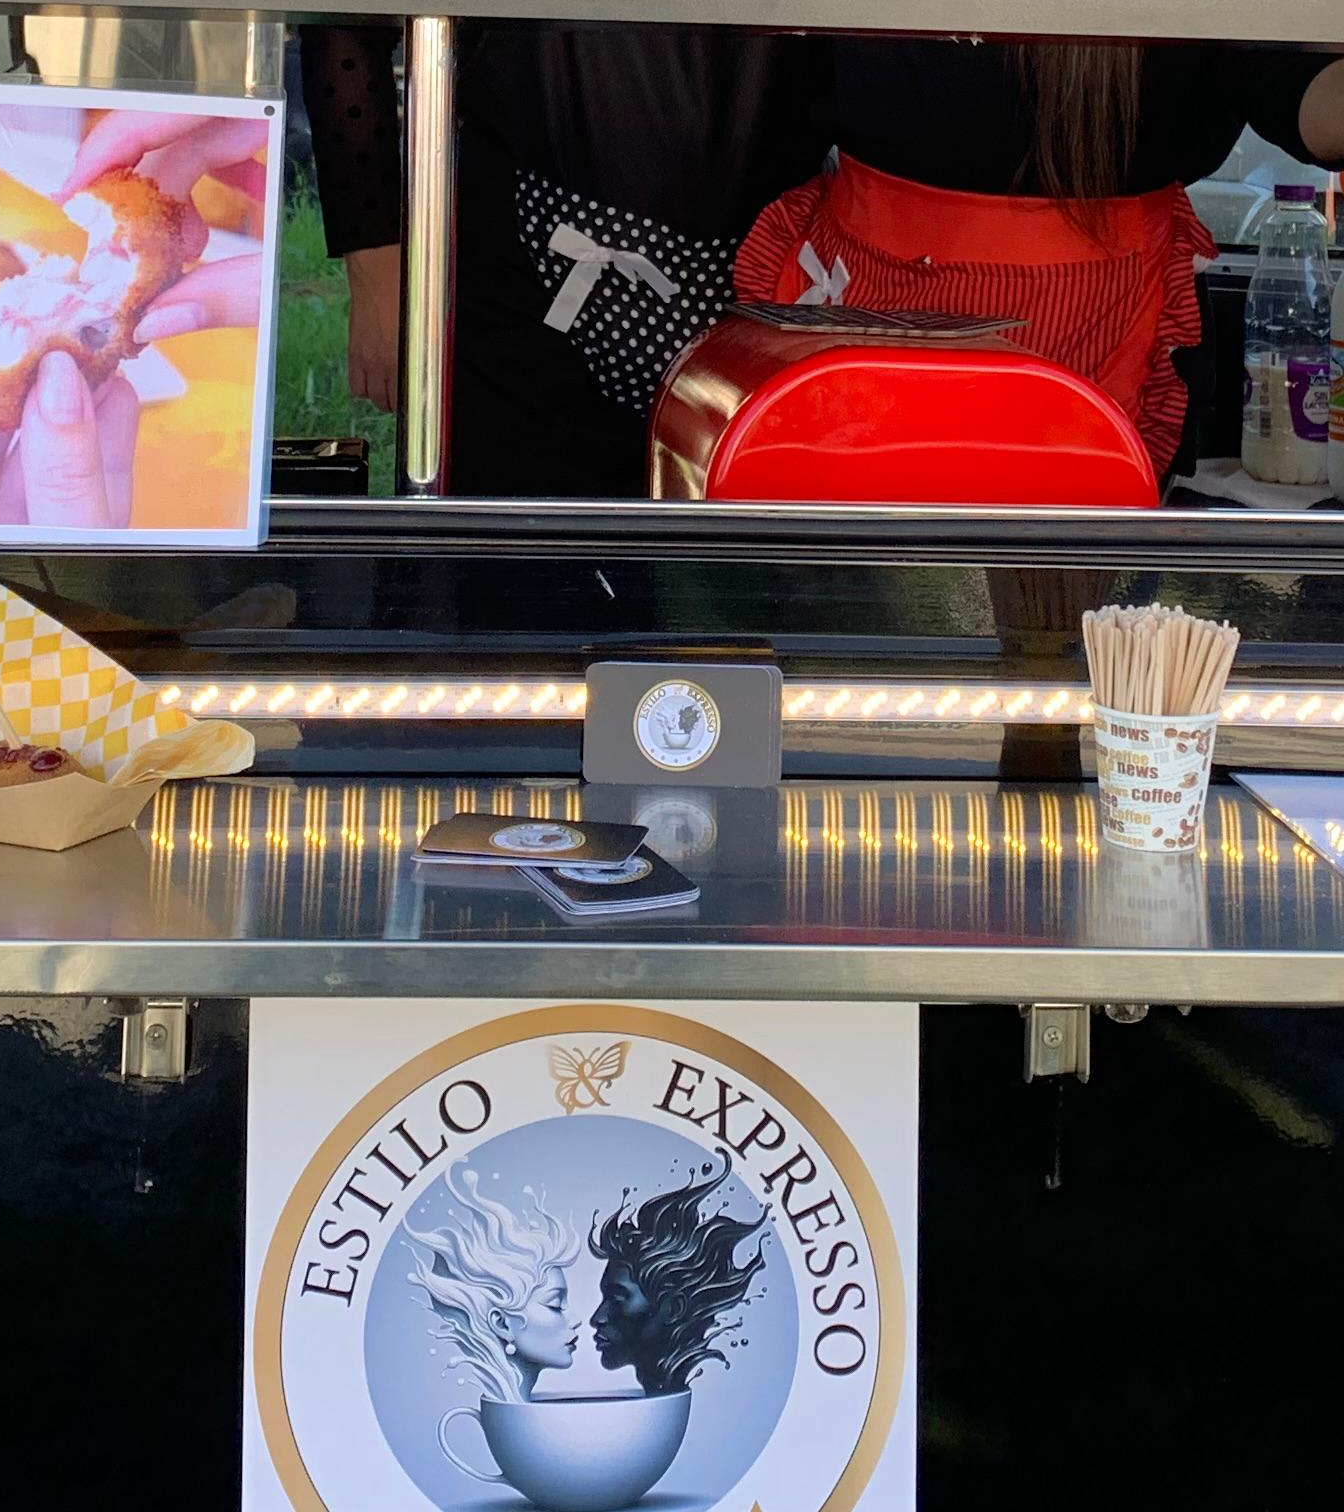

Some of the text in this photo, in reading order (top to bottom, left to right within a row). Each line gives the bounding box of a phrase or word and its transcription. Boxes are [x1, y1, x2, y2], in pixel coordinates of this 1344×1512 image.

[640, 688, 666, 720] ESTILO
[1110, 723, 1150, 743] news
[1117, 761, 1159, 780] news
[1131, 788, 1183, 804] coffee
[1112, 808, 1152, 826] coffee
[300, 1078, 493, 1308] ESTILO
[652, 1059, 867, 1376] EXPRESSO
